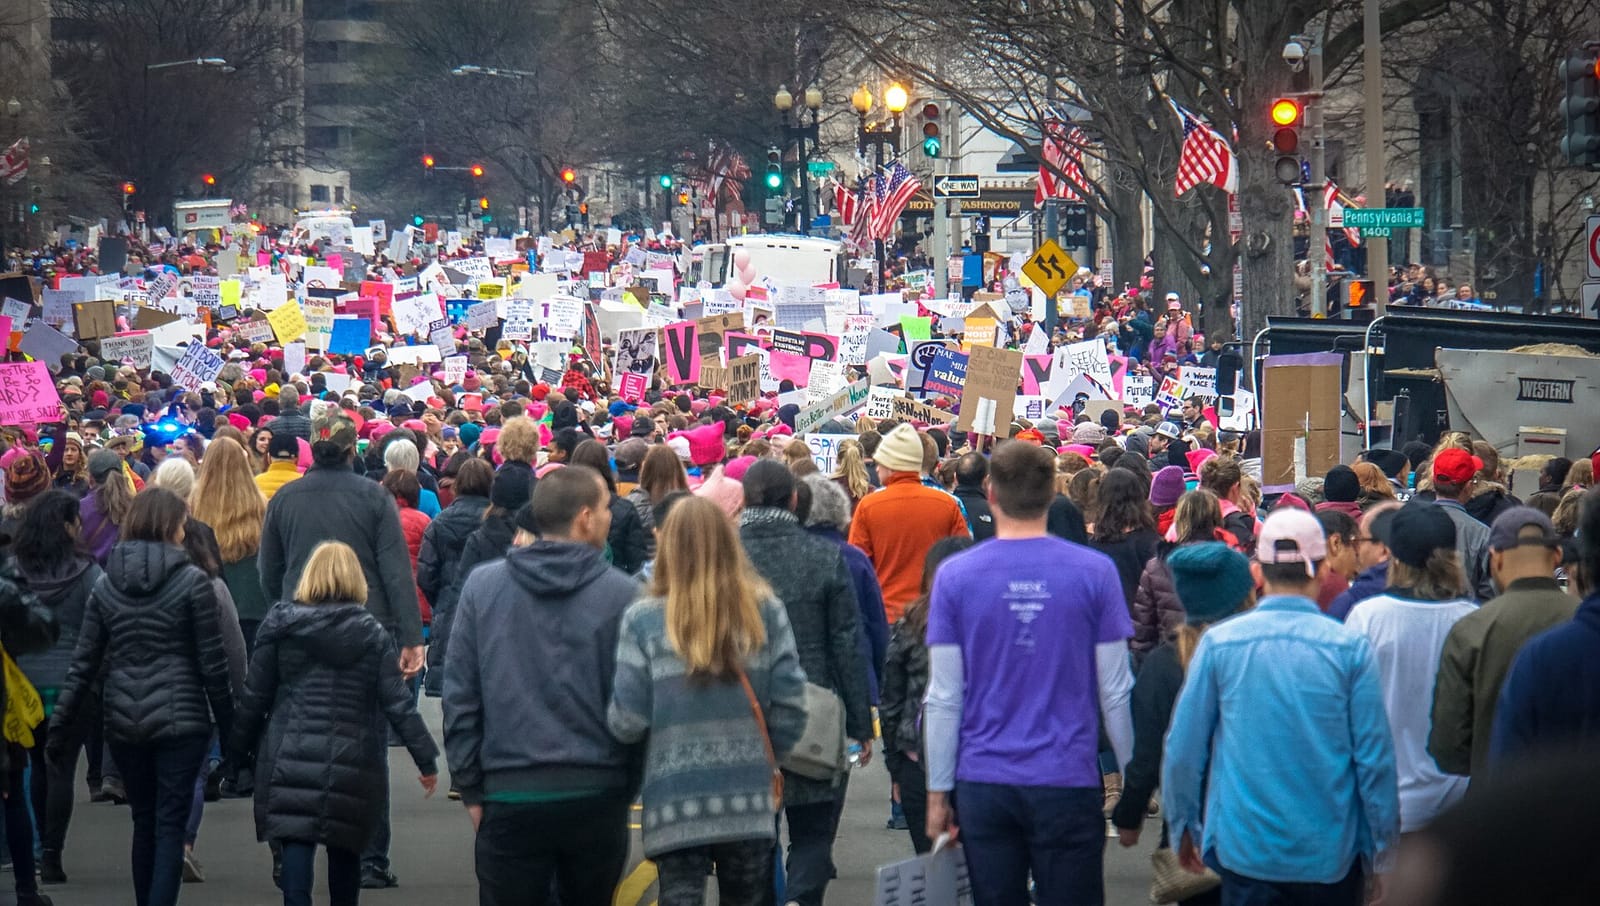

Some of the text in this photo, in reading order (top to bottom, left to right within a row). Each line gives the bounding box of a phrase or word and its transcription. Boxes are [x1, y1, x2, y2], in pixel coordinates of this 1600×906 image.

[942, 182, 977, 190] ONE WAY
[1345, 211, 1412, 226] Pennsylvania
[1362, 228, 1390, 237] 1400
[104, 338, 145, 349] THANK YOU
[188, 339, 224, 372] MY BODY
[667, 326, 695, 380] V
[1071, 349, 1101, 364] SEEK
[179, 352, 216, 382] MY VOICE
[171, 364, 203, 394] MY POWE
[0, 385, 40, 406] ARD?
[1126, 386, 1152, 396] FUTURE
[1522, 380, 1570, 400] WESTERN
[17, 409, 34, 421] SHE
[868, 409, 892, 418] EART
